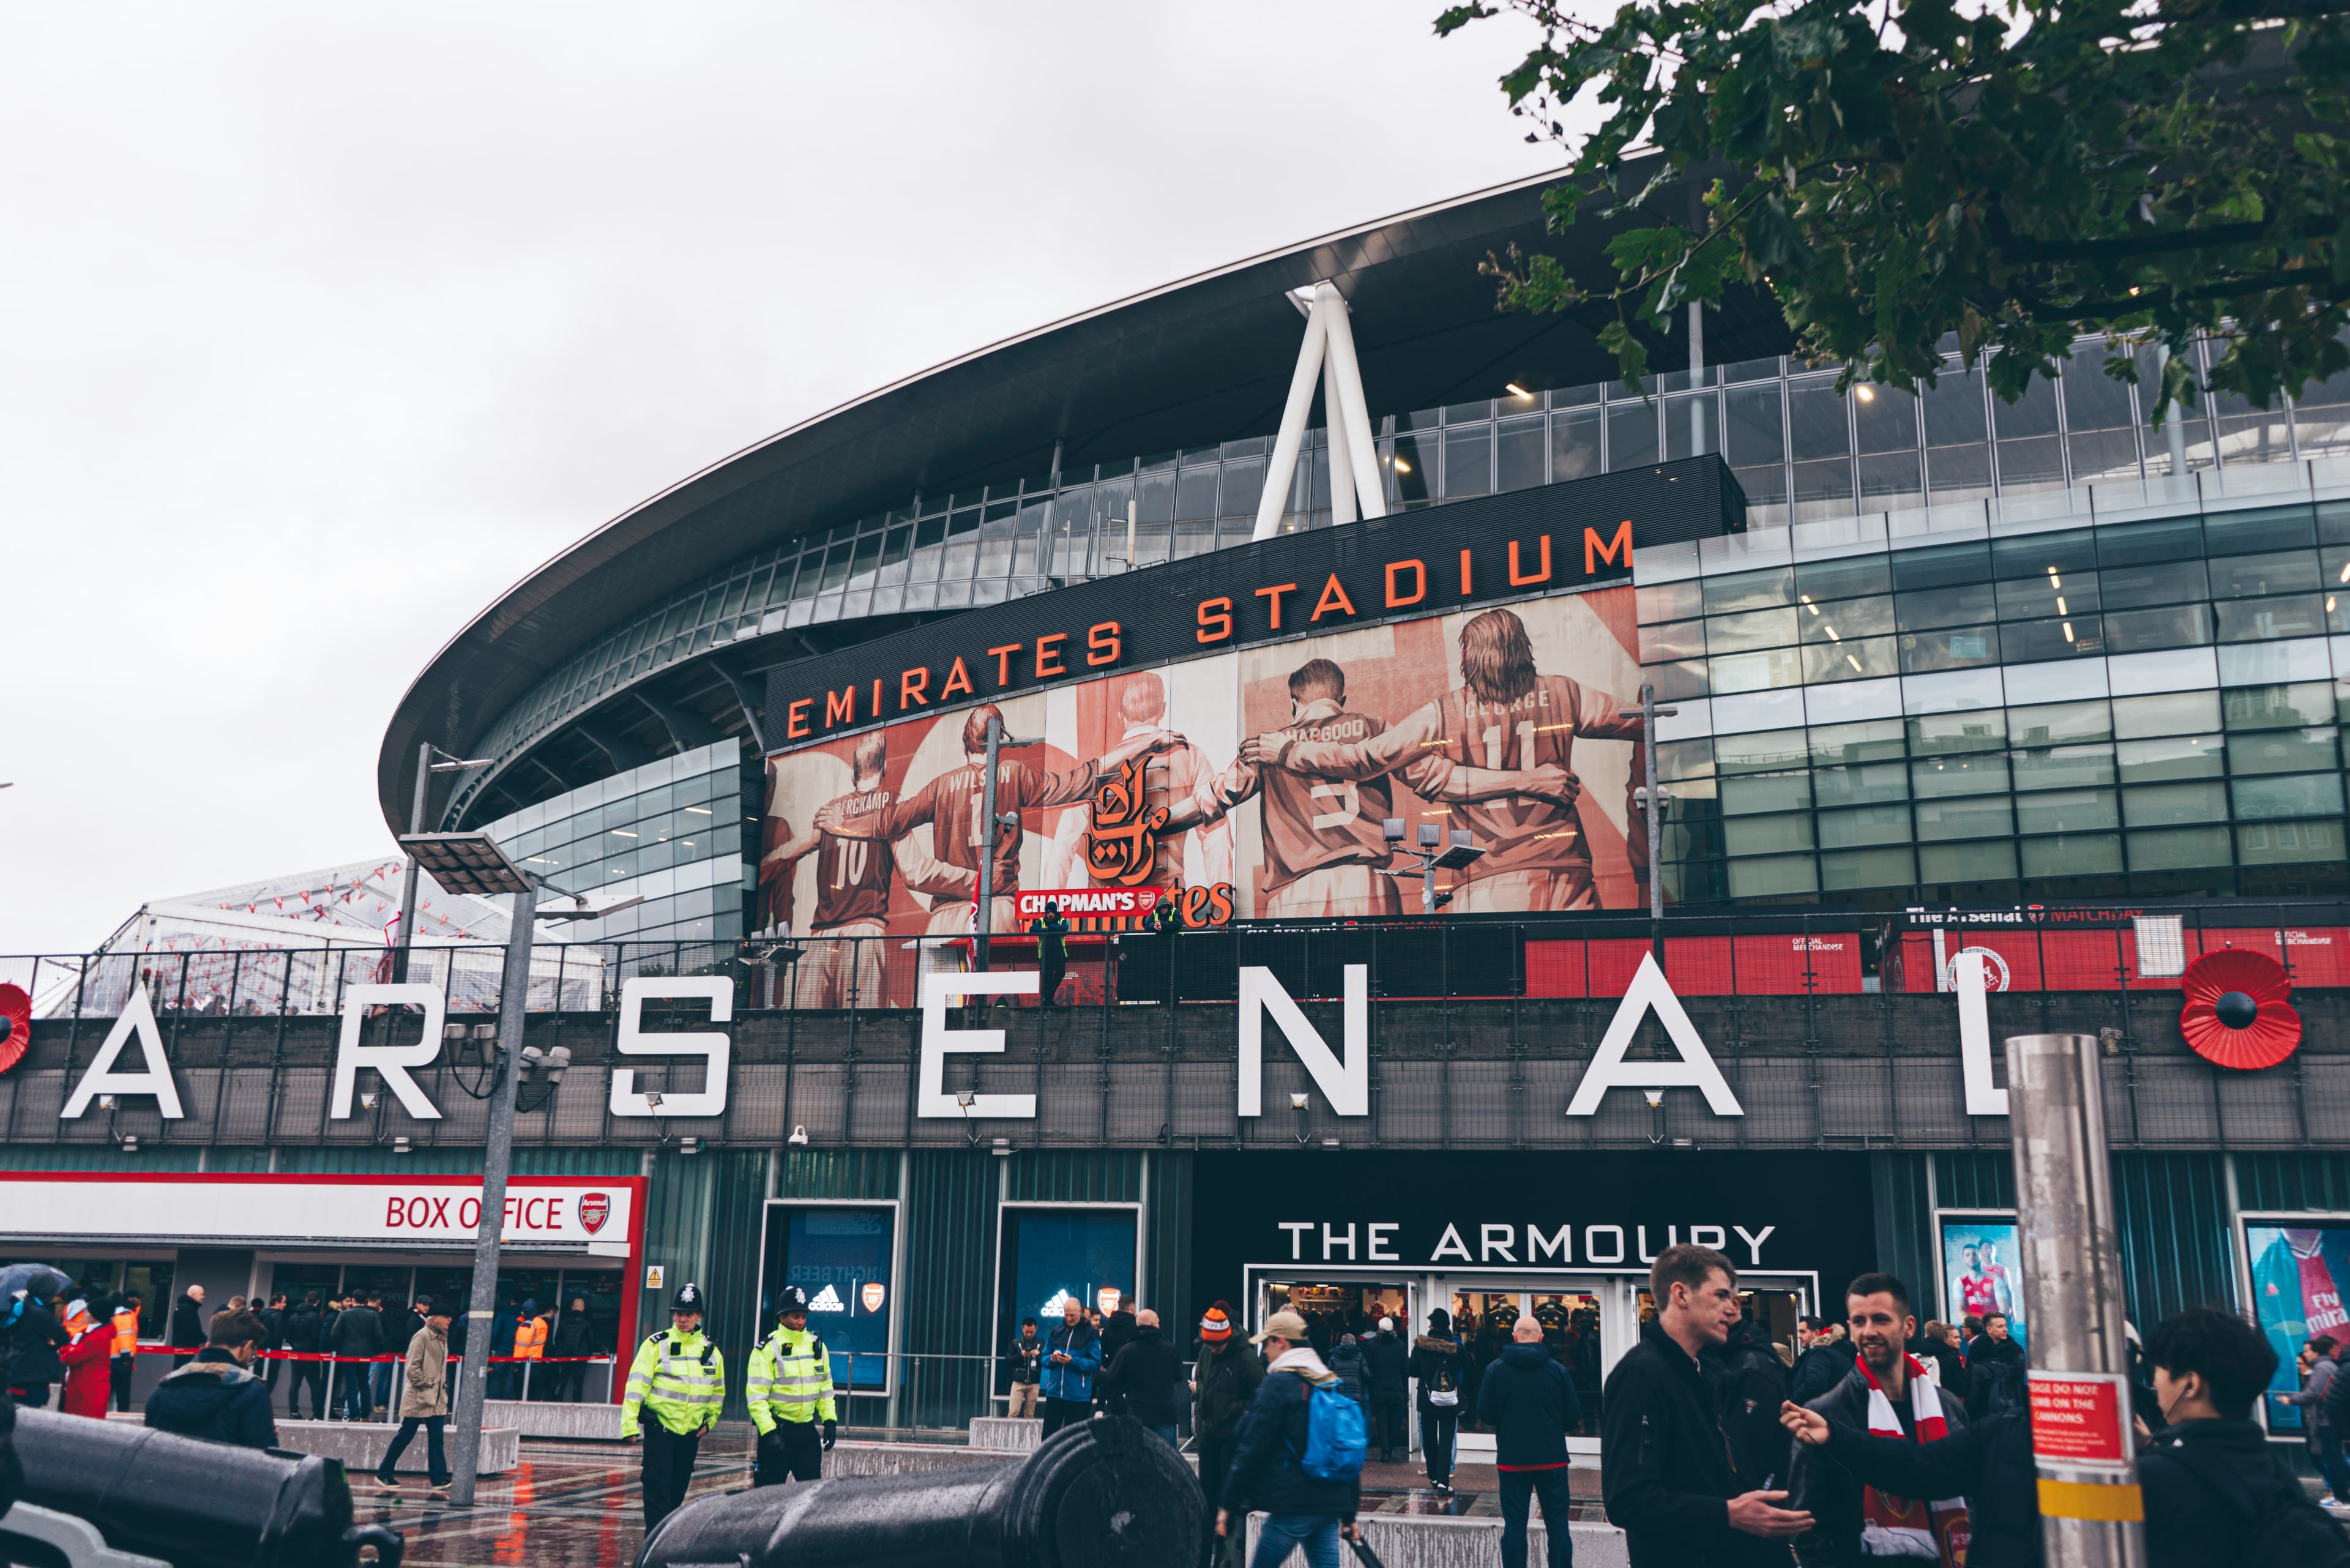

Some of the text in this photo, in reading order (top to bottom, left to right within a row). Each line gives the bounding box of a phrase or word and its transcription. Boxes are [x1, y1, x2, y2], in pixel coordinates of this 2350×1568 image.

[787, 520, 1633, 739] EMIRATES STADIUM
[1286, 719, 1363, 742] HAPGOOD
[950, 765, 1010, 794] WILSN
[835, 837, 868, 888] 10
[1020, 892, 1135, 913] CHAPMAN'S
[61, 950, 2010, 1119] ARSENAL
[386, 1197, 564, 1230] BOX OFICE
[1278, 1222, 1400, 1261] THE
[2311, 1291, 2339, 1309] Fly
[2053, 1383, 2071, 1395] DO
[2073, 1384, 2098, 1396] NOT
[2053, 1398, 2070, 1408] ON
[2071, 1399, 2095, 1410] THE
